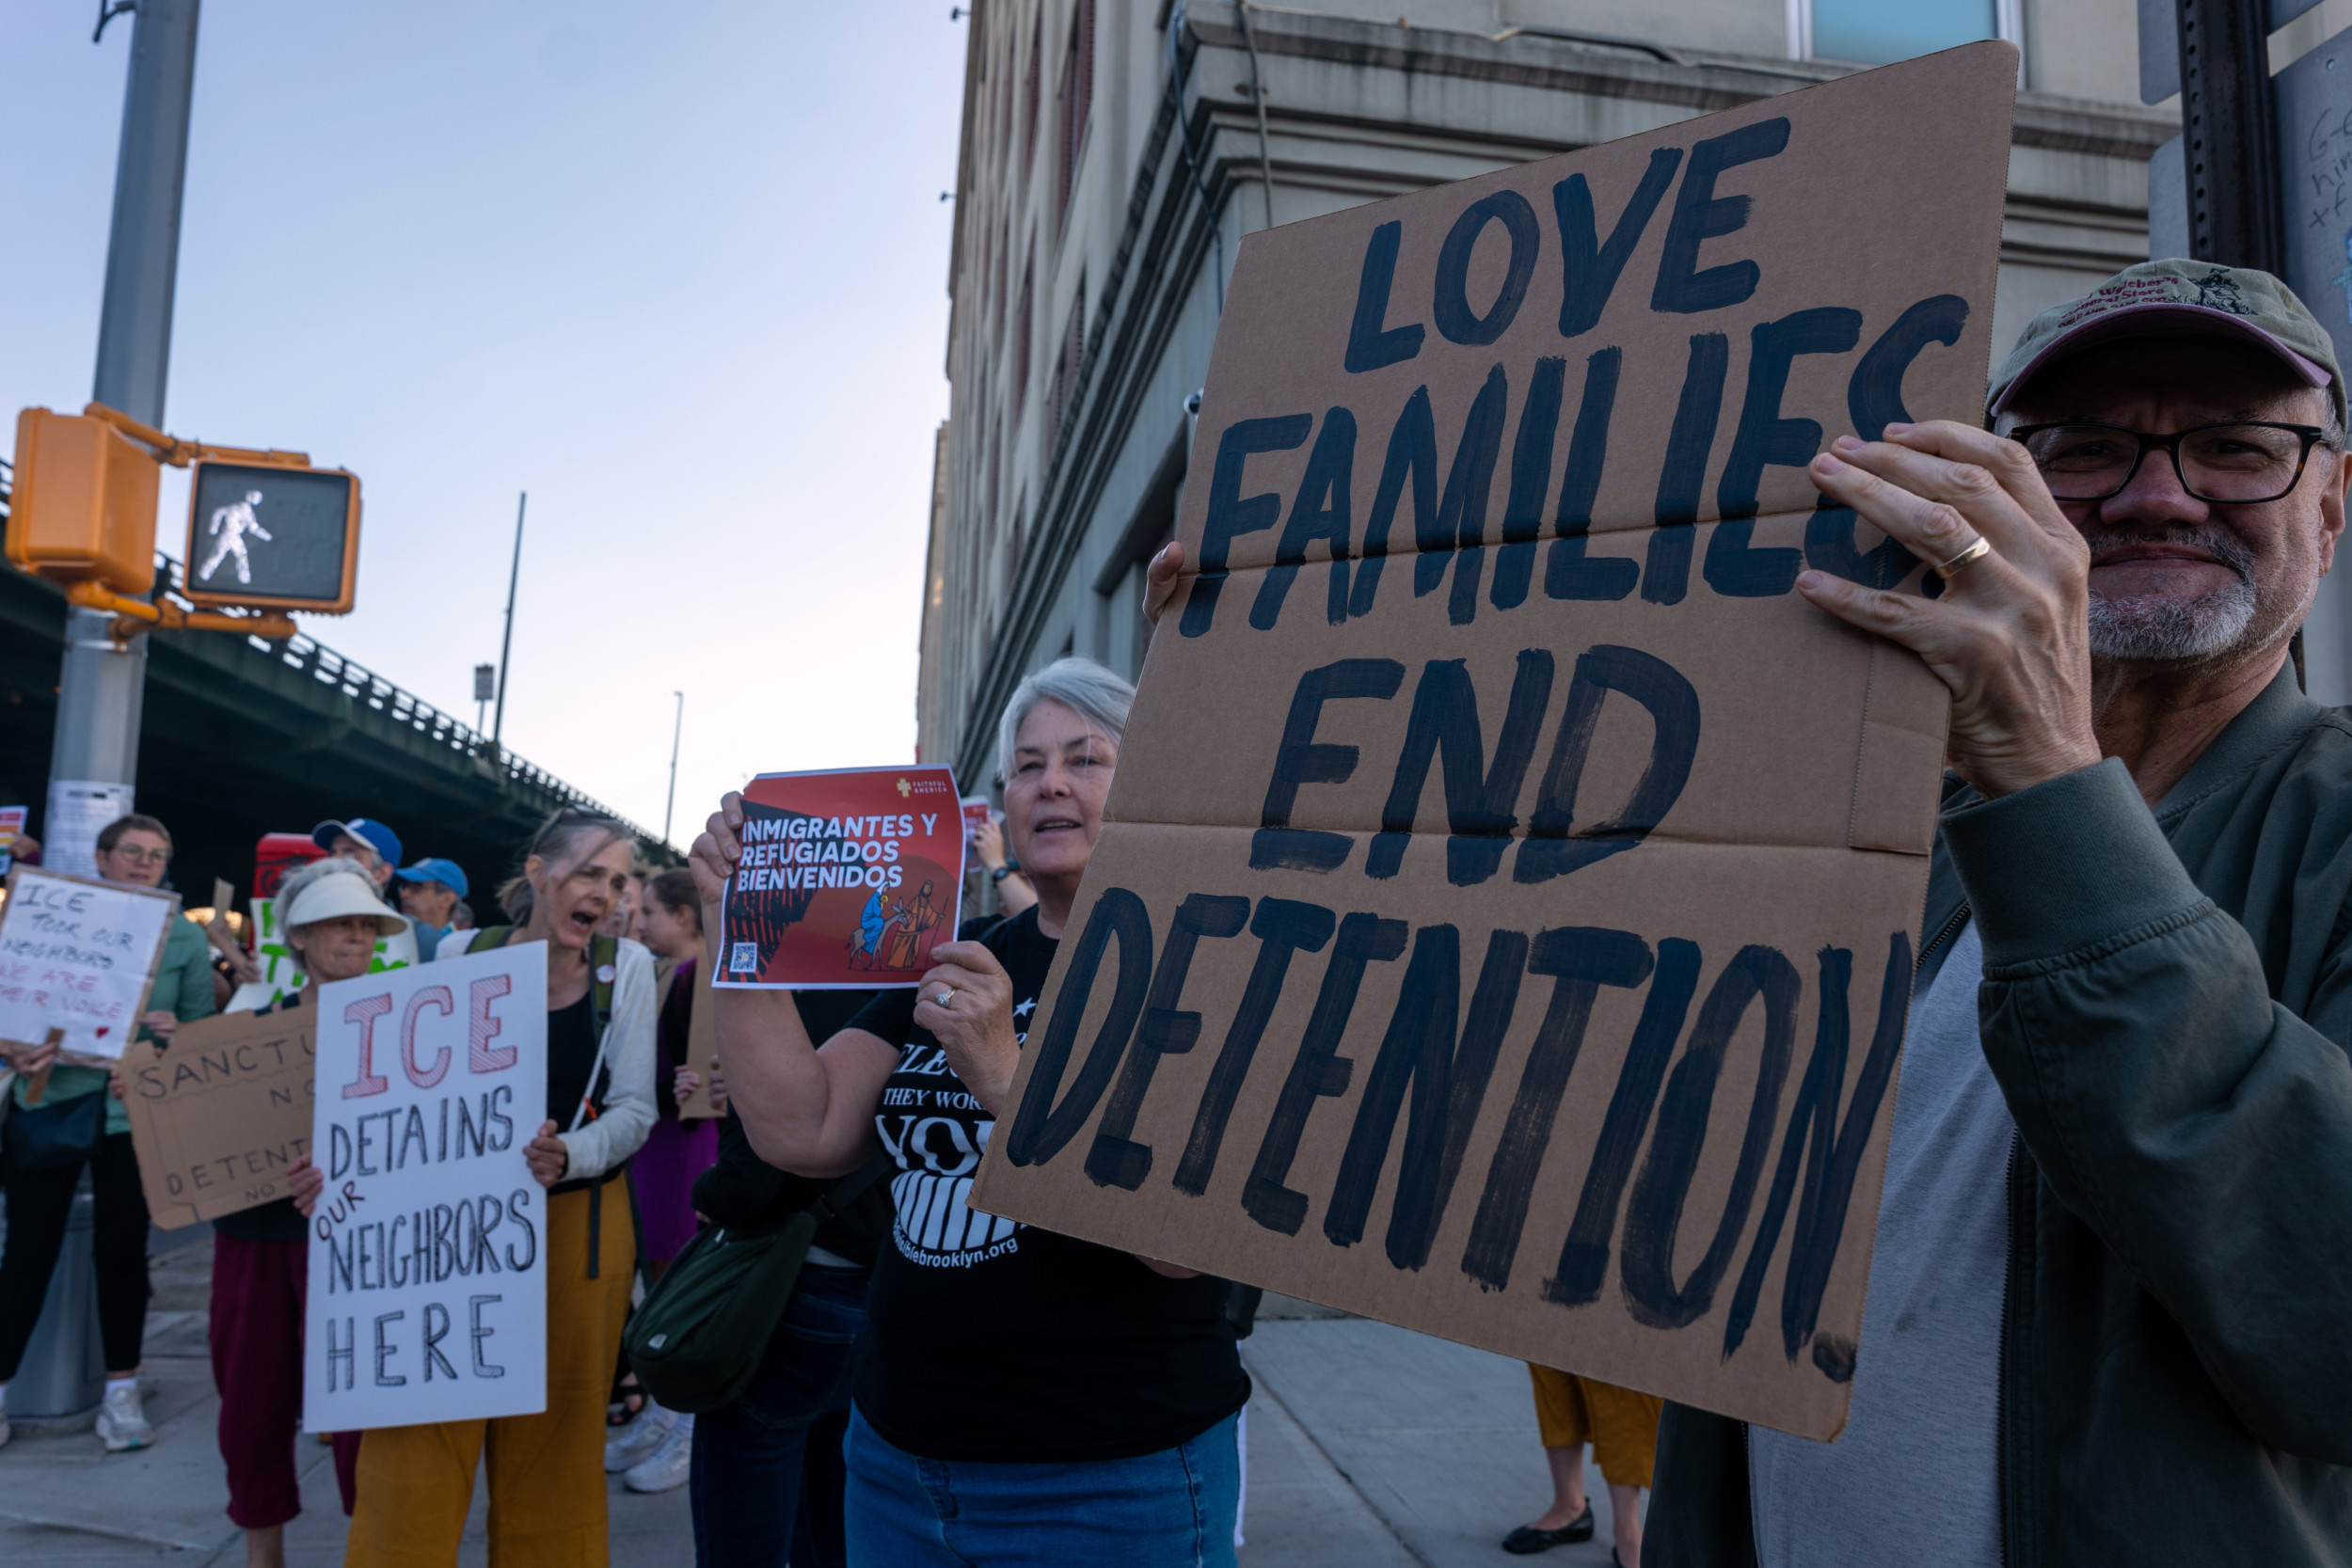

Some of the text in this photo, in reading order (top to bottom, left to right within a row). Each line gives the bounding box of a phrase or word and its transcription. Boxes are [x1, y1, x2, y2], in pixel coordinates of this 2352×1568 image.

[1344, 117, 1791, 373] LOVE
[2122, 289, 2164, 300] Store
[1179, 293, 1971, 639] FAMILIES
[1248, 643, 1701, 886] END
[742, 815, 914, 843] INMIGRANTES
[921, 813, 938, 836] Y
[738, 865, 903, 892] BIENVENIDOS
[739, 840, 899, 867] REFUGIADOS
[15, 883, 95, 913] ICE
[3, 938, 114, 970] NEIGHBORS
[31, 912, 135, 952] TOOK OUR
[0, 984, 123, 1020] HEIR VOICE
[40, 969, 99, 992] ARE
[342, 974, 517, 1100] ICE
[138, 1033, 315, 1100] SANCTU
[883, 1087, 987, 1111] THEY WOR
[329, 1085, 513, 1181] DETAINS
[166, 1136, 307, 1196] DETENT
[315, 1180, 365, 1241] OUR
[328, 1189, 537, 1294] NEIGHBORS
[326, 1294, 505, 1393] HERE
